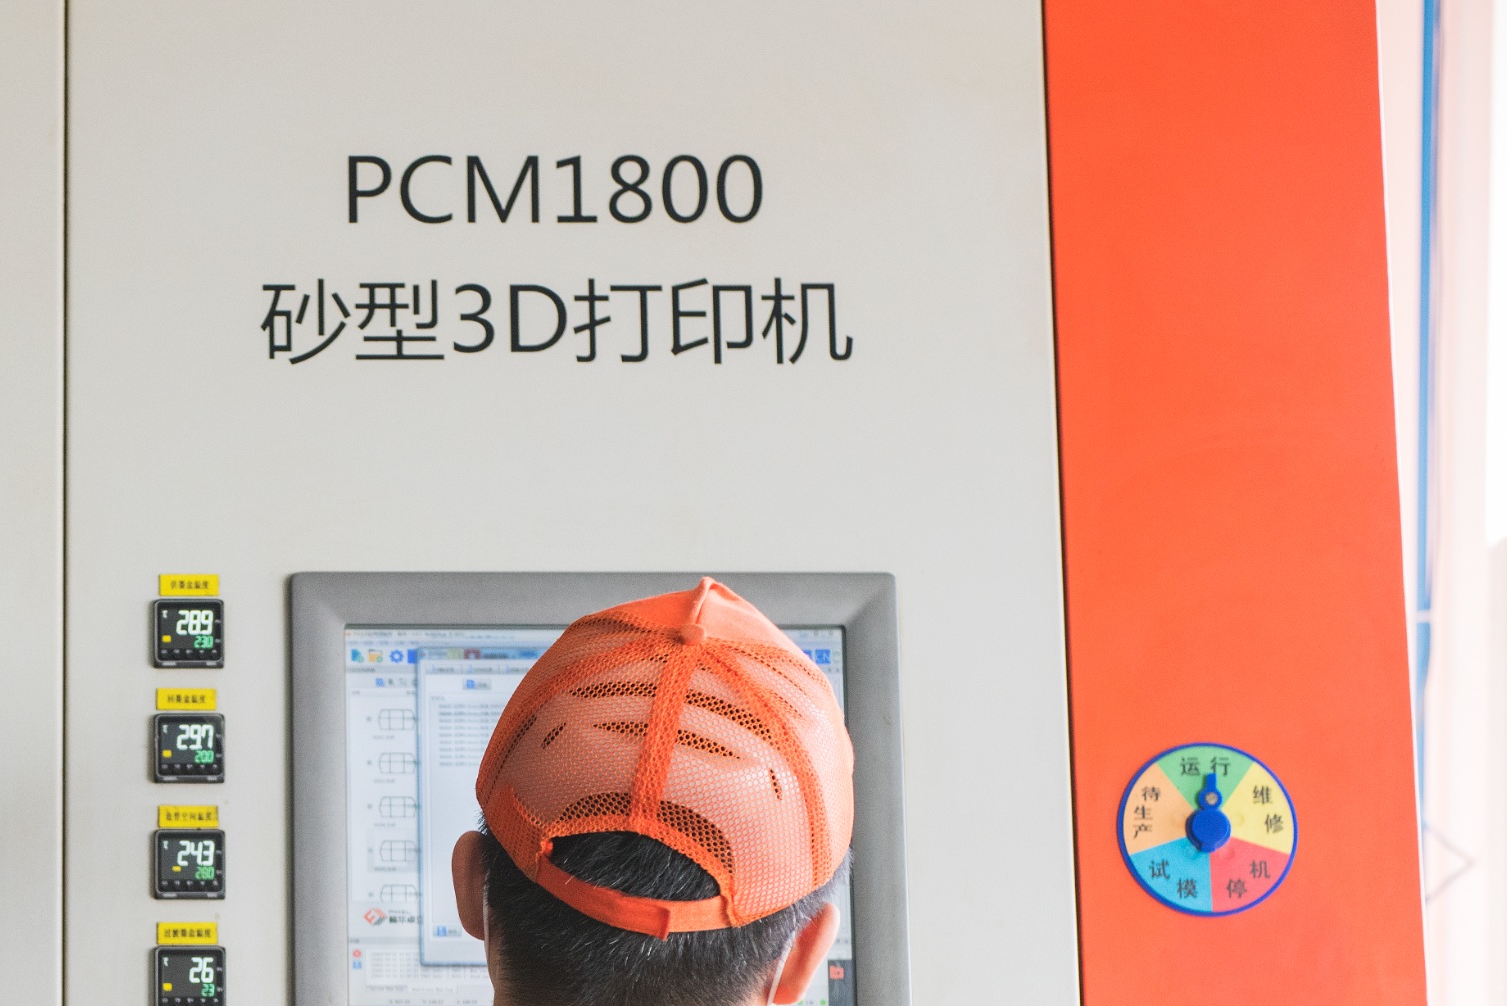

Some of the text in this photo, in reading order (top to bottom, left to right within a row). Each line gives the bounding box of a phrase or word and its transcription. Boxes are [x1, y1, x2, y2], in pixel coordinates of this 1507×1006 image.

[347, 154, 764, 224] PCM1800
[259, 277, 854, 365] 砂型3D打印机
[1179, 756, 1231, 777] 运行
[1133, 785, 1161, 839] 待生产
[1252, 785, 1284, 834] 维修
[1149, 859, 1197, 899] 试模
[188, 957, 214, 984] 26
[201, 983, 215, 997] 23
